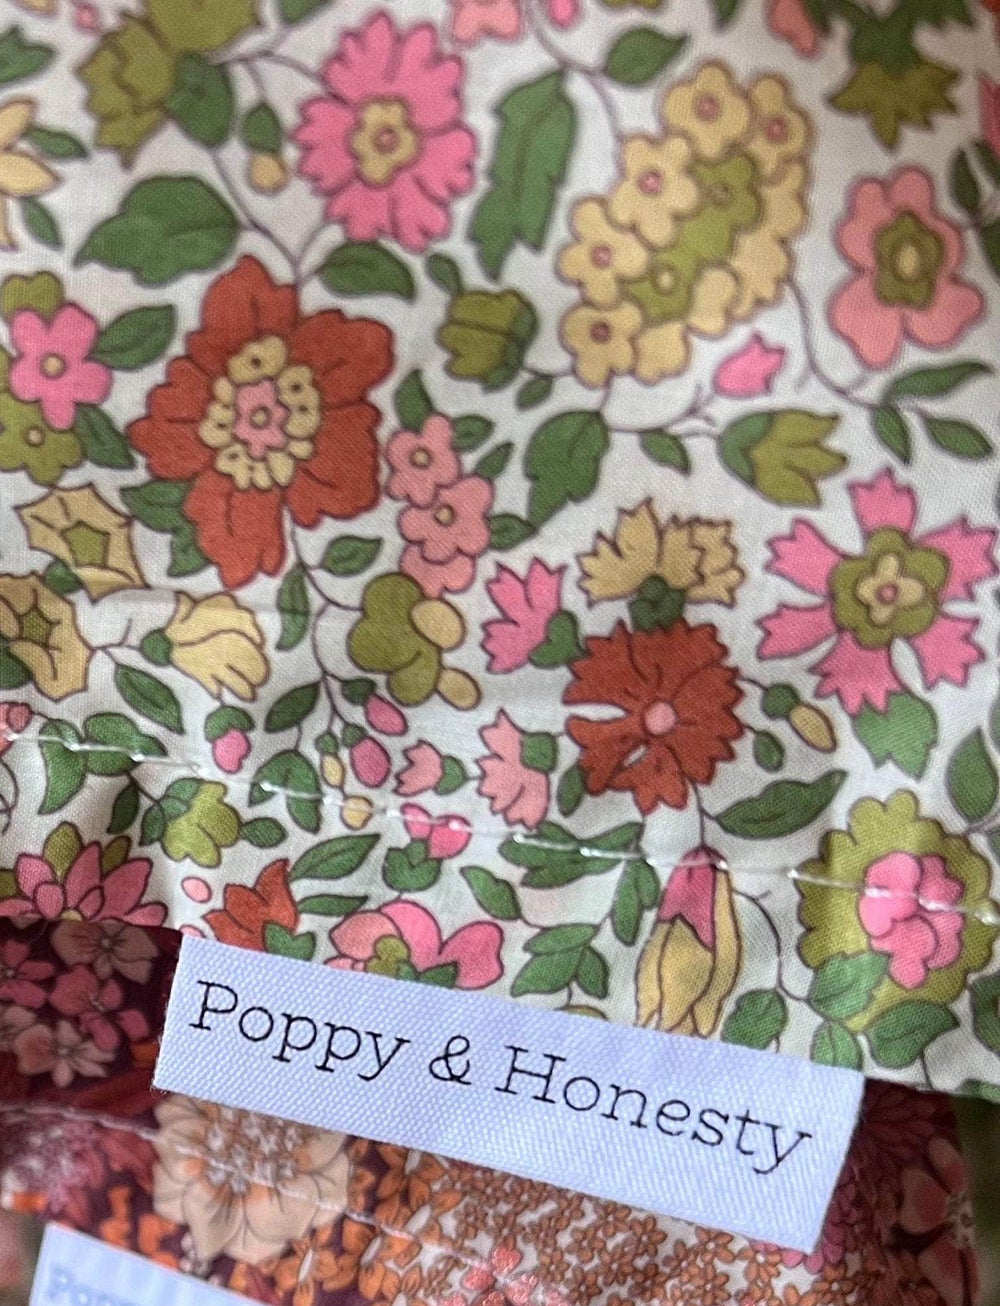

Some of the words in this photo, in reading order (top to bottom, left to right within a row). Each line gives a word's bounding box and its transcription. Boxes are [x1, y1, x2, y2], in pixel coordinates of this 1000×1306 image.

[188, 979, 411, 1082] Poppy
[427, 1034, 473, 1086] &
[493, 1044, 813, 1175] Honesty
